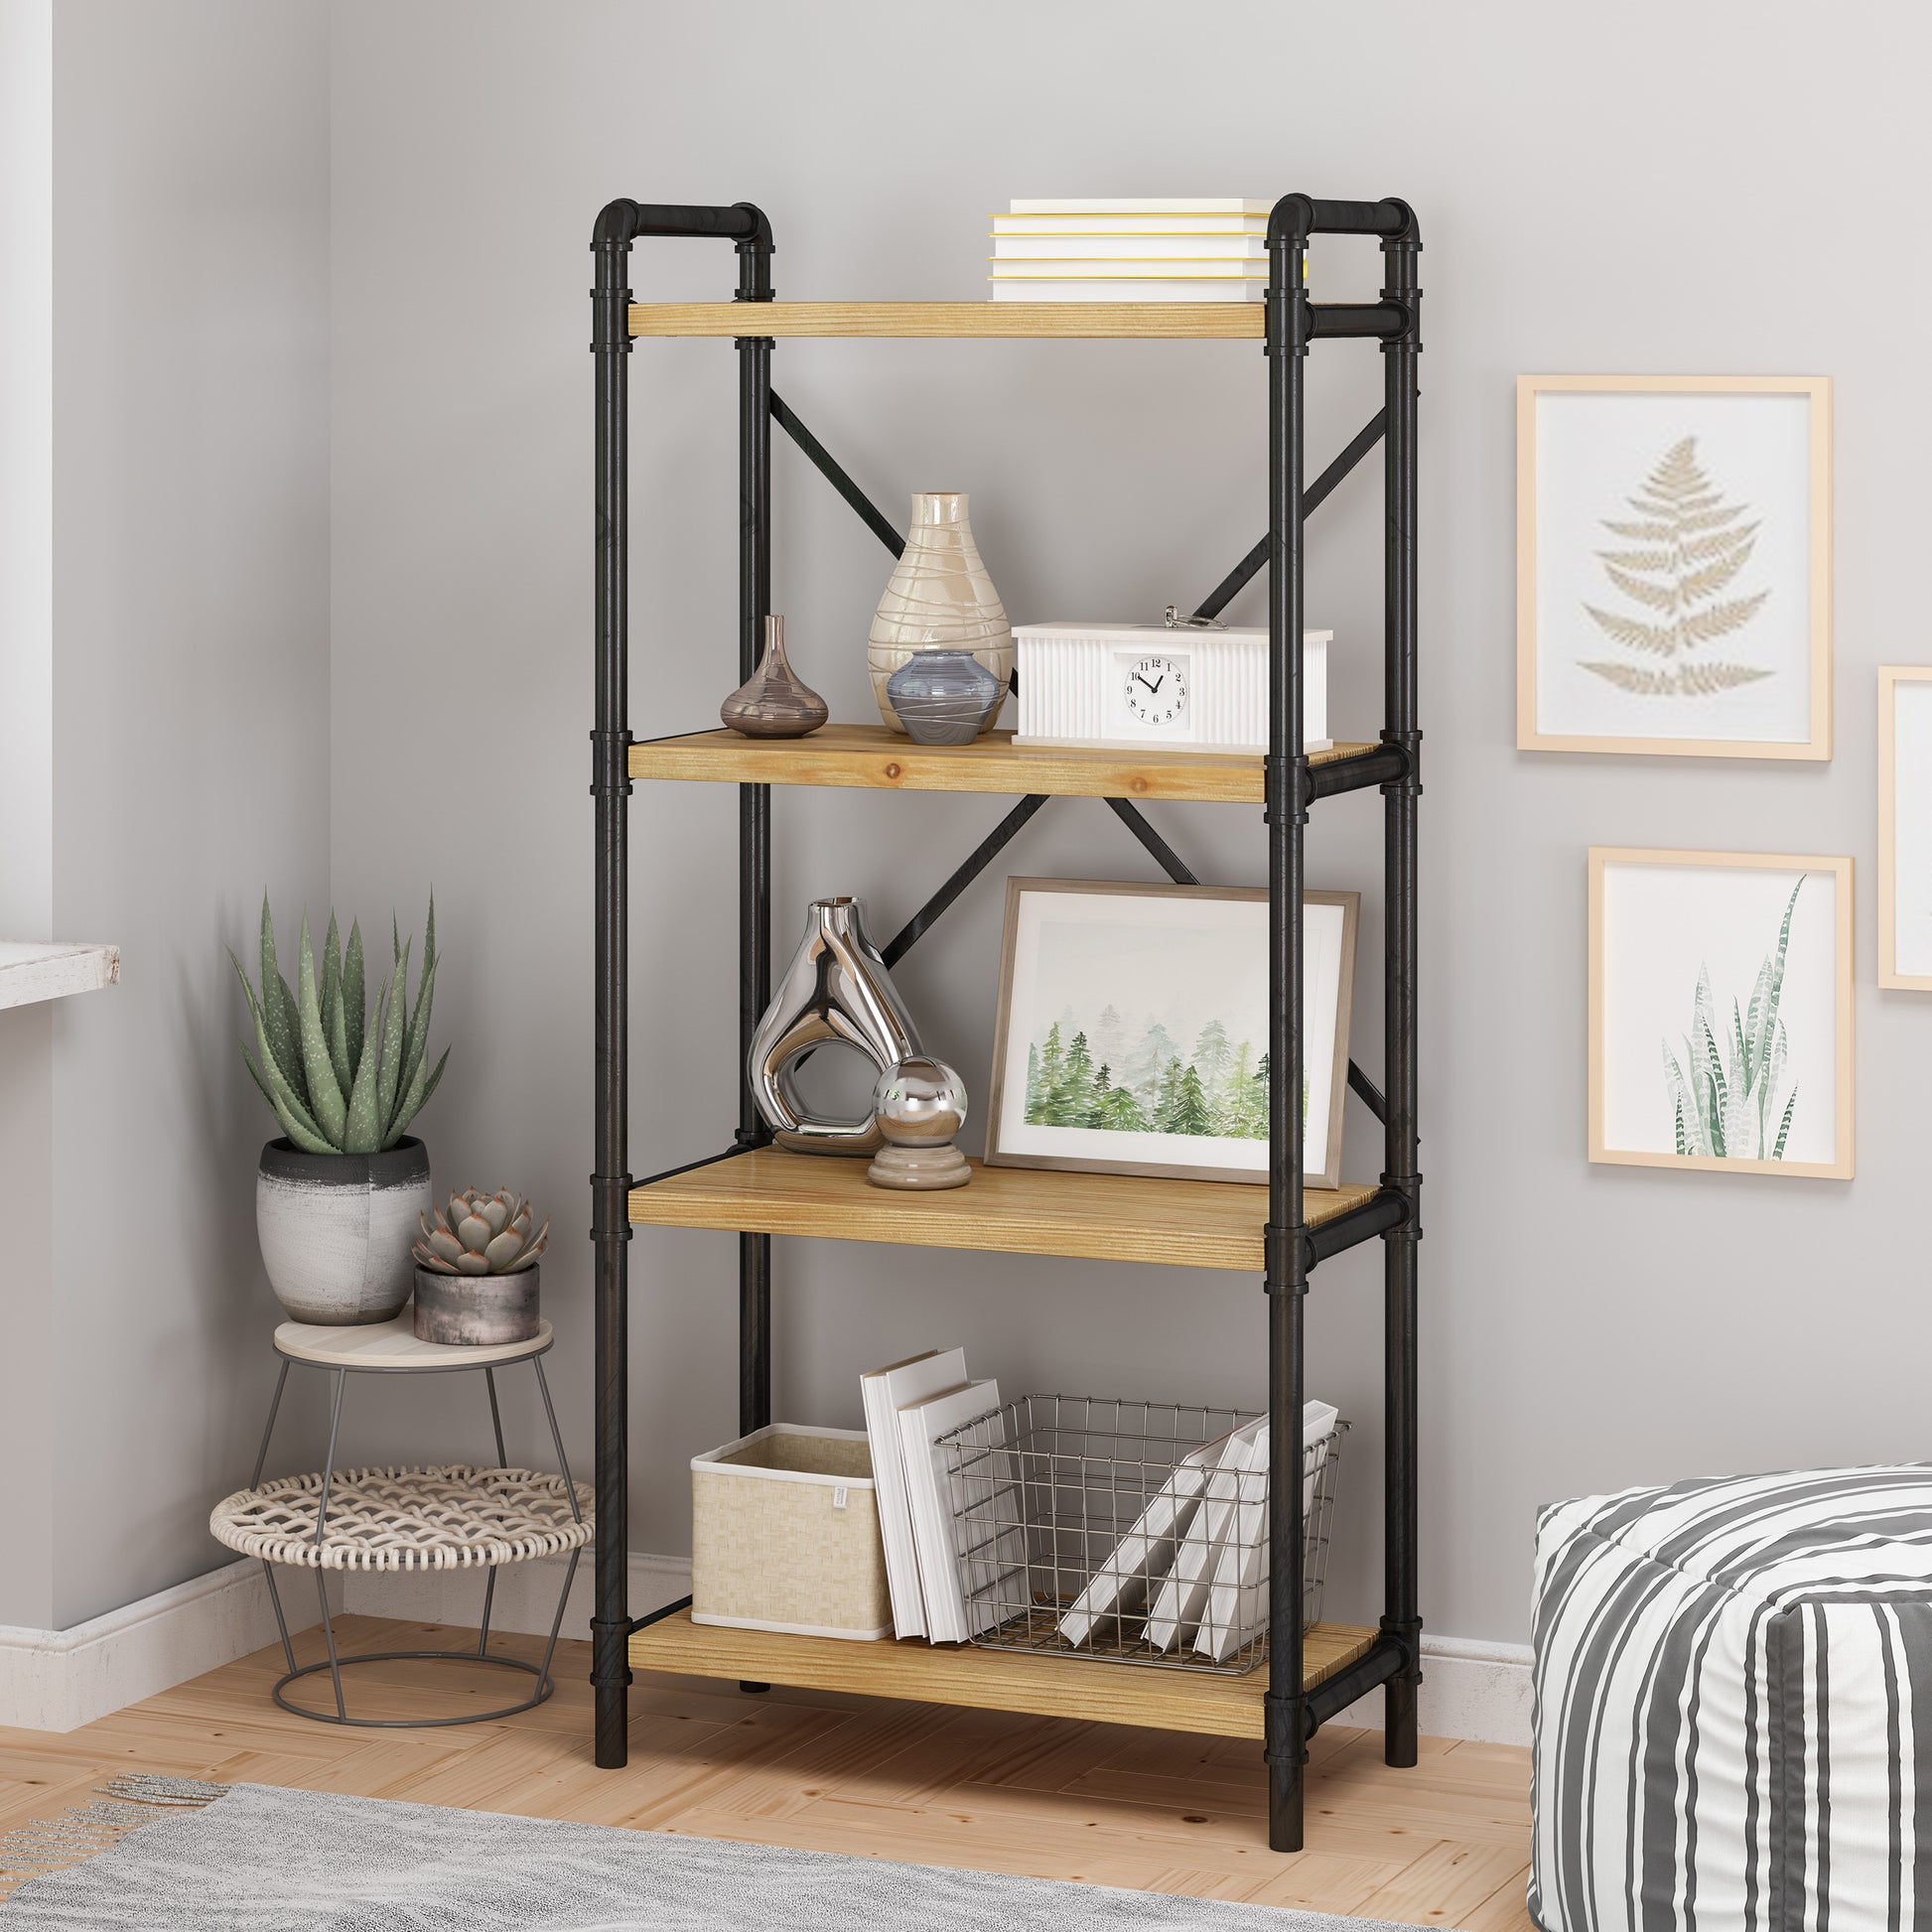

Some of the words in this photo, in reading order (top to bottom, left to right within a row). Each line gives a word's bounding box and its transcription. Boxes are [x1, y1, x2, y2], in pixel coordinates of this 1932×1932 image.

[1141, 662, 1149, 671] 11
[1152, 658, 1161, 668] 12
[1167, 662, 1171, 671] 1
[1131, 672, 1141, 681] 10
[1175, 673, 1181, 682] 2
[1127, 686, 1133, 695] 9
[1178, 687, 1185, 696] 3
[1130, 699, 1137, 708] 8
[1175, 699, 1181, 709] 4
[1141, 709, 1146, 718] 7
[1166, 710, 1173, 719] 5
[1153, 714, 1159, 723] 6
